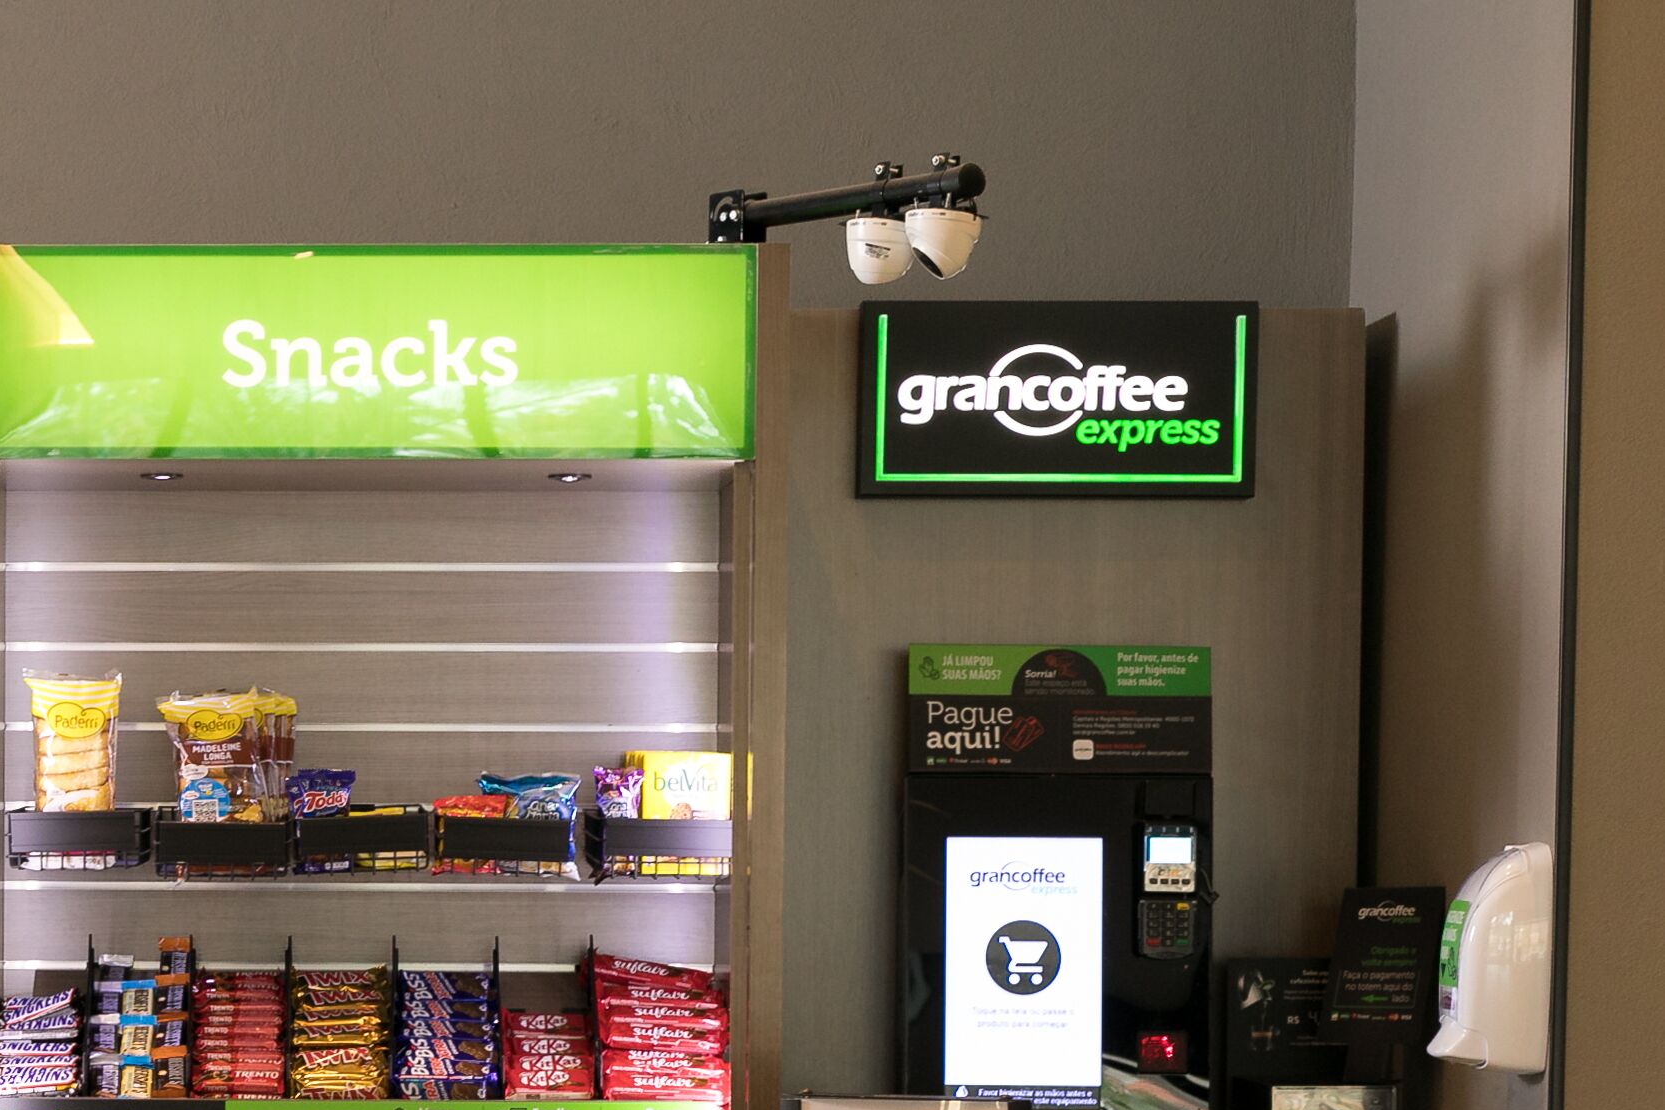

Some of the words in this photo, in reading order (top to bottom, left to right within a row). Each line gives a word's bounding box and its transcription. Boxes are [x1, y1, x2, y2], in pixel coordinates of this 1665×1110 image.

[222, 319, 519, 388] Snacks
[897, 365, 1189, 425] grancoffee
[1075, 418, 1220, 452] express
[942, 655, 954, 667] JÁ
[955, 656, 994, 667] LIMPOU
[1117, 652, 1133, 663] Por
[1134, 652, 1160, 665] favor,
[1161, 654, 1186, 664] antes
[1187, 654, 1199, 664] de
[942, 669, 968, 680] SUAS
[969, 667, 1002, 680] MÃOS?
[1024, 669, 1058, 680] Sorria!
[1117, 665, 1142, 677] pagar
[1143, 664, 1186, 677] higienize
[1117, 678, 1137, 687] suas
[1138, 677, 1166, 687] mãos.
[54, 713, 99, 730] Paderri
[926, 701, 1014, 730] Pague
[193, 718, 236, 733] Paderri
[192, 742, 242, 753] MADELEINE
[926, 726, 1001, 755] aqui!
[203, 752, 232, 762] LONGA
[653, 768, 719, 793] belVita
[304, 791, 349, 813] Toddy
[970, 867, 1066, 888] grancoffee
[1358, 905, 1416, 921] grancoffee
[1370, 972, 1416, 982] pagamento
[3, 989, 71, 1022] SNICKERS
[235, 1071, 280, 1080] TRENTO
